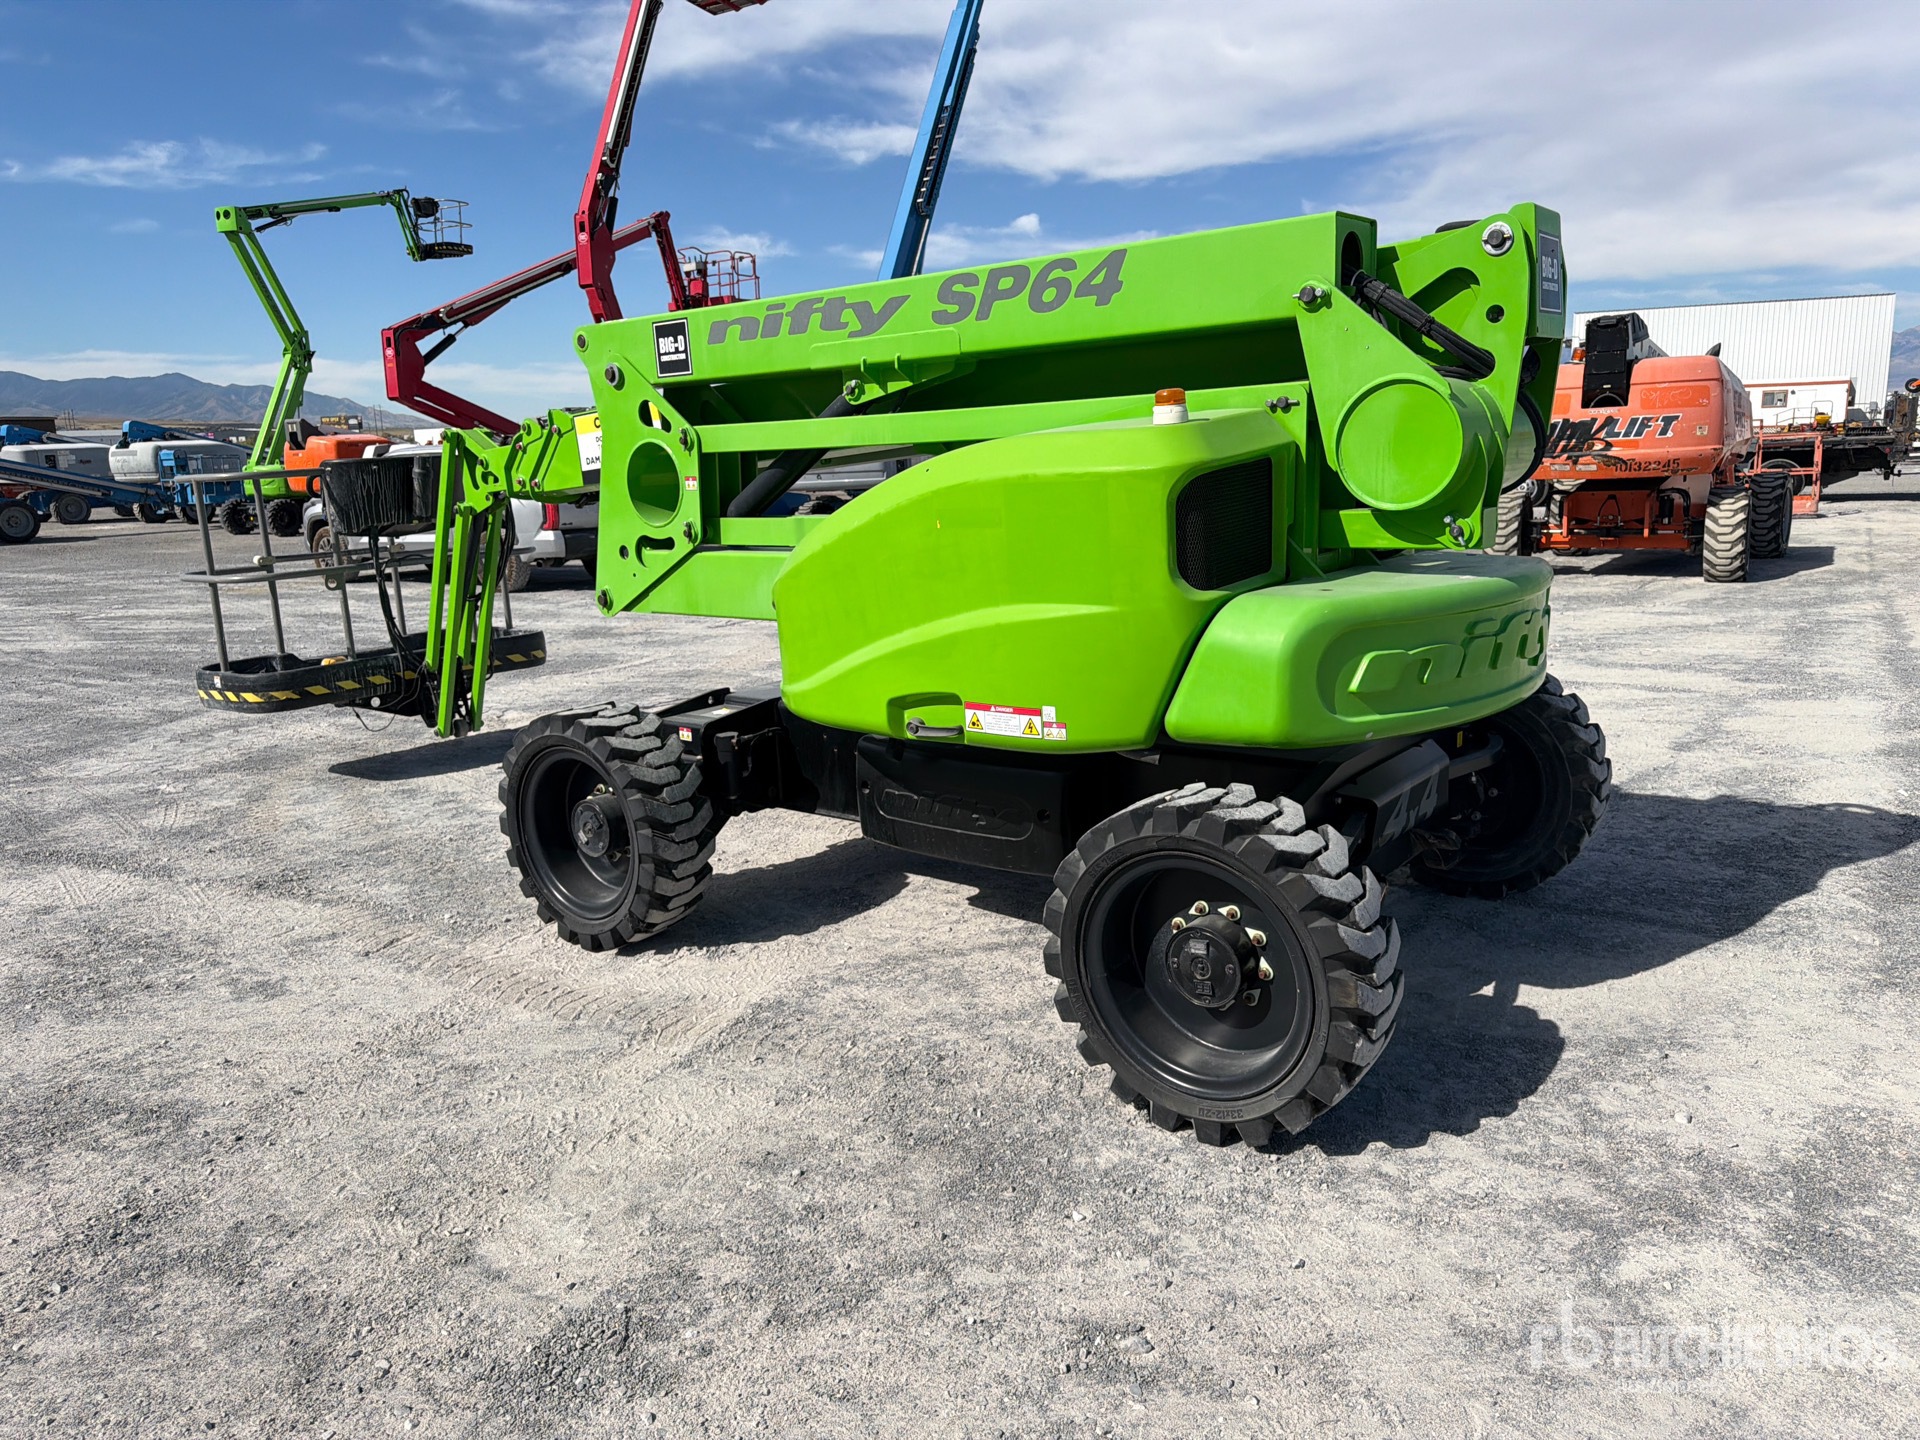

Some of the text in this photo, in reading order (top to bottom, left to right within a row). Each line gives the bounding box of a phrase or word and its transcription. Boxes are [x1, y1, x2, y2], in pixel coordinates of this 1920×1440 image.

[1542, 255, 1558, 280] BIG-D
[707, 248, 1128, 345] nifty SP64
[658, 335, 685, 354] BIG-D
[585, 455, 602, 466] DAM
[1347, 607, 1550, 694] nift
